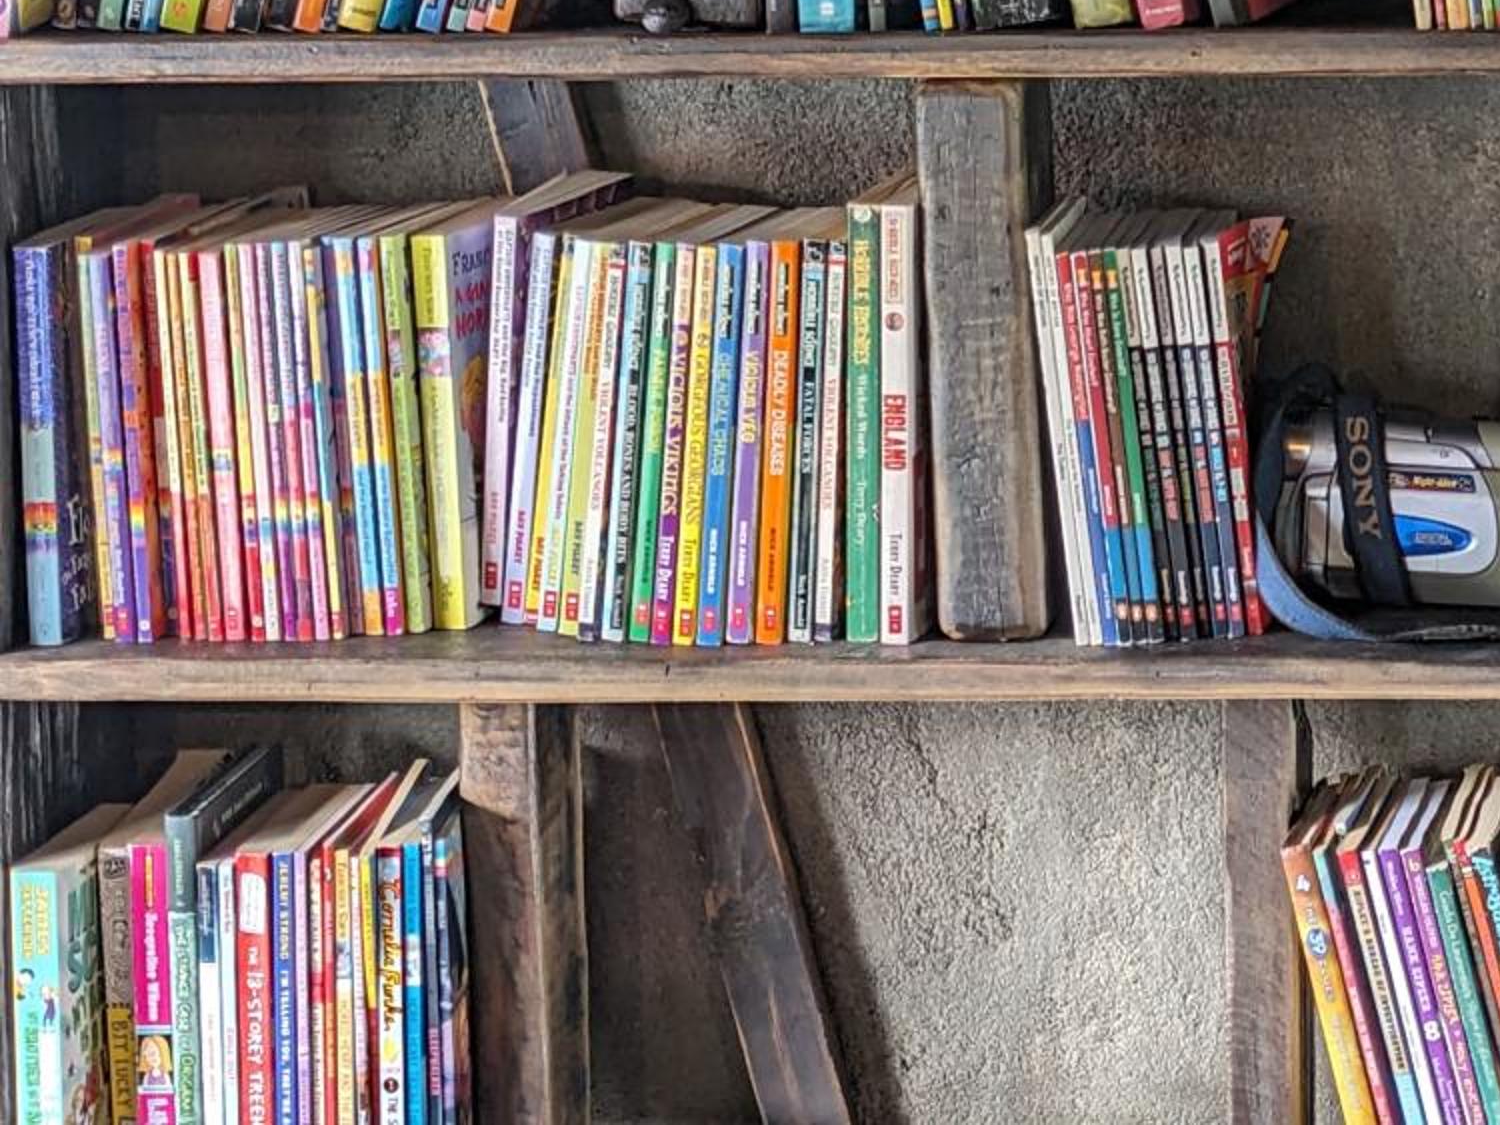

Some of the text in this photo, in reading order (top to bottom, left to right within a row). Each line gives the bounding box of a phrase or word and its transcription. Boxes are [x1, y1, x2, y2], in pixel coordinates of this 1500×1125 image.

[883, 394, 907, 472] ENGLAND
[662, 435, 684, 516] VIKINGS
[1346, 415, 1383, 539] SONY
[657, 569, 673, 603] DEARY
[889, 534, 903, 608] TERRY DEARY
[1295, 873, 1313, 894] 4
[278, 911, 289, 959] STRONG
[379, 879, 400, 967] Cornelia
[142, 912, 159, 1021] Jacqueline Wilson
[246, 970, 265, 1063] 13-STOREY
[1422, 1018, 1441, 1042] 8
